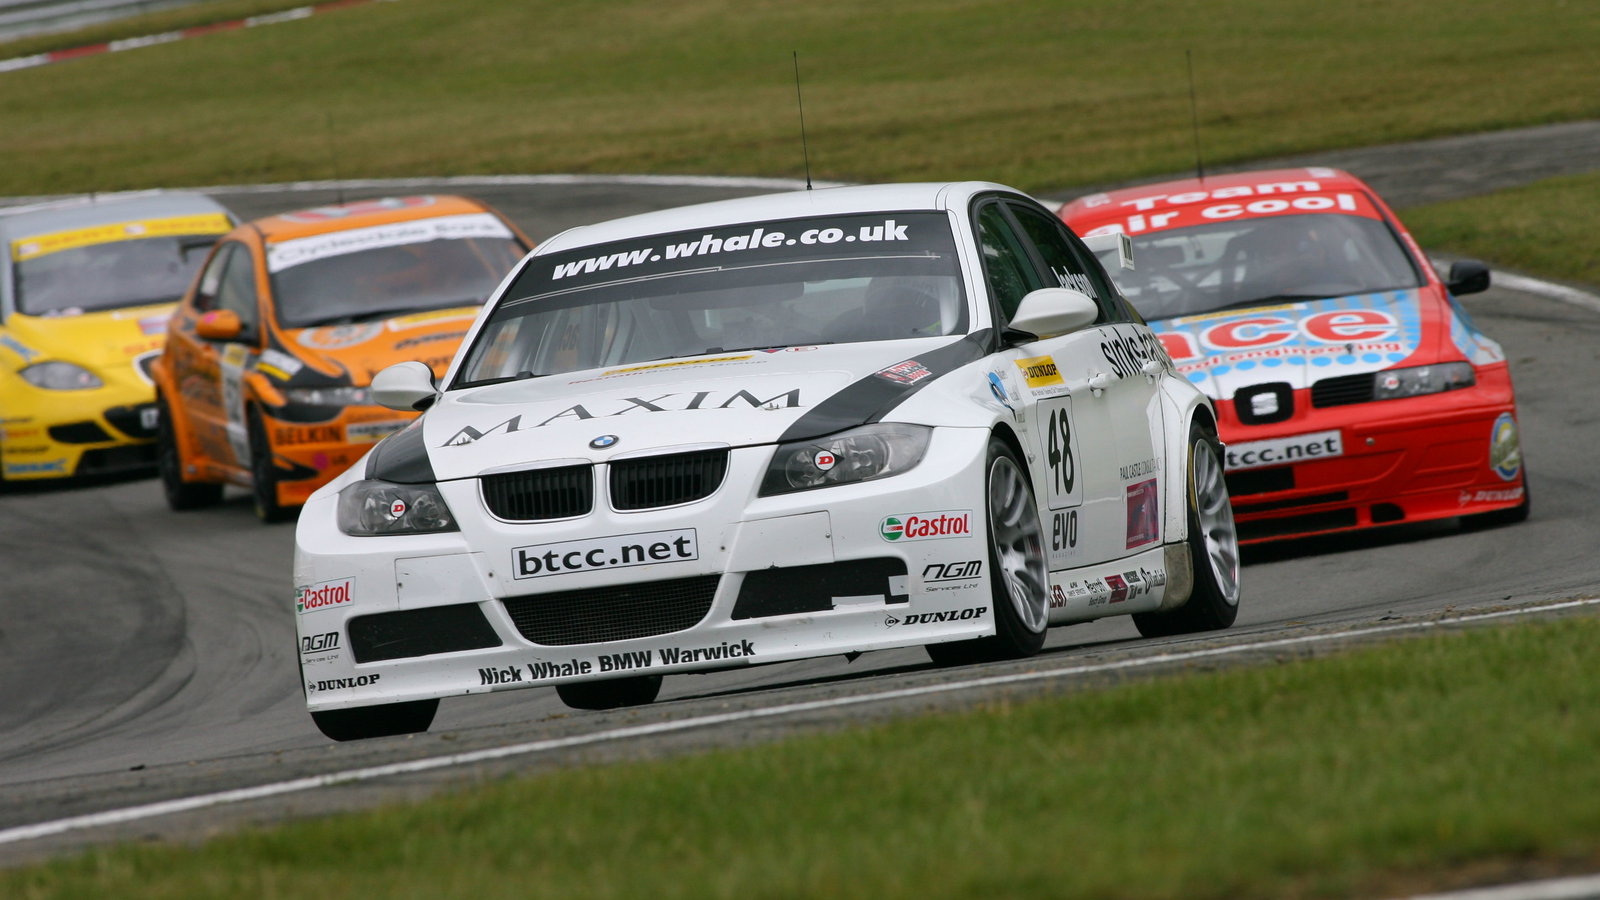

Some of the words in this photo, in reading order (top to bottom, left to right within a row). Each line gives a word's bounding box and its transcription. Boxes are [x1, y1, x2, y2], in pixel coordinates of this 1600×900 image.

[1120, 181, 1320, 211] Team
[1201, 193, 1357, 219] cool
[552, 219, 909, 281] www.whale.co.uk
[1027, 363, 1057, 379] DUNLOP
[434, 388, 804, 448] MAXIM
[273, 426, 342, 446] BELKIN
[1048, 407, 1075, 496] 48
[1226, 437, 1338, 467] tcc.net
[904, 513, 969, 538] Castrol
[1052, 510, 1078, 552] evo
[518, 535, 693, 576] btcc.net
[304, 581, 351, 610] Castrol
[925, 585, 962, 593] Services
[902, 606, 988, 626] DUNLOP
[478, 666, 522, 686] Nick
[527, 658, 592, 681] Whale
[598, 649, 652, 673] BMW
[658, 639, 756, 665] Warwick
[317, 673, 381, 692] DUNLOP
